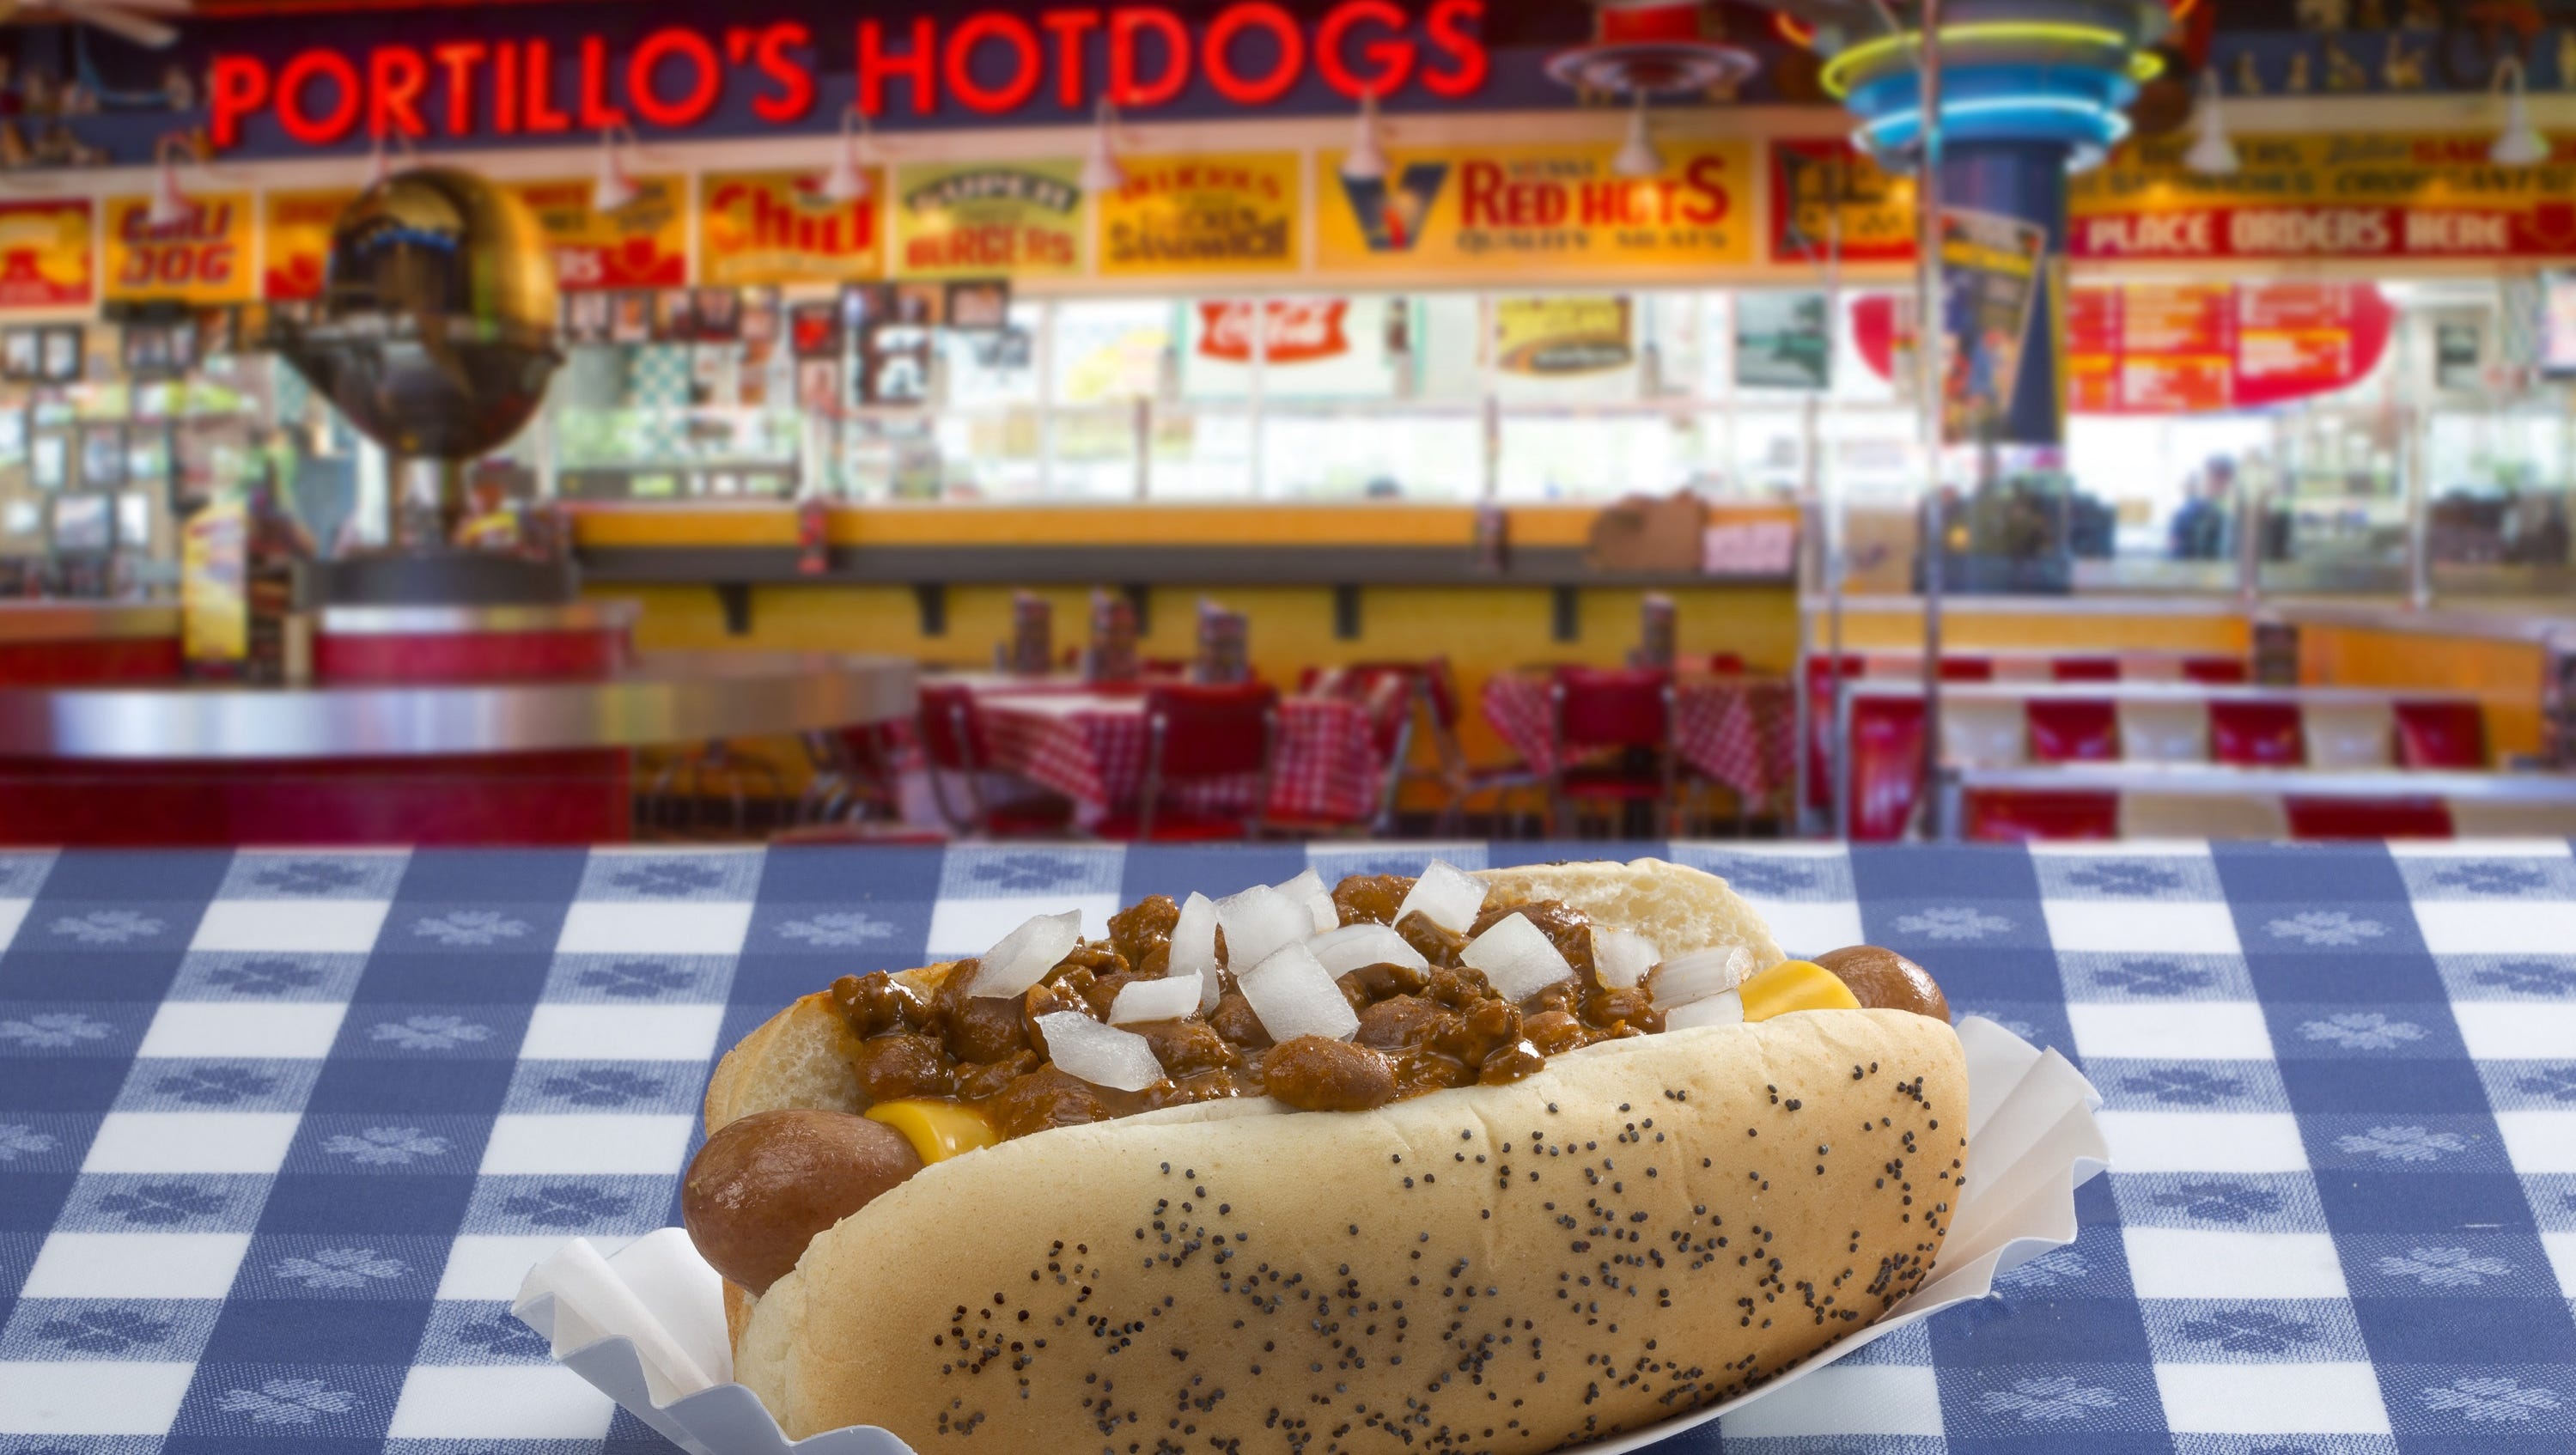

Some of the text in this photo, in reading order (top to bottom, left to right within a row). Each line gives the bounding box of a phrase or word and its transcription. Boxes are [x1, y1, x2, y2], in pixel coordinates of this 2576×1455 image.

[210, 0, 1489, 149] PORTILLO'S HOTDOGS
[1459, 159, 1570, 229] RED
[1577, 153, 1733, 227] HOTS
[904, 222, 1077, 271] BURGERS
[1455, 229, 1591, 254] QUALITY
[2086, 207, 2510, 253] PLACE ORDERS HERE
[119, 241, 237, 287] DOG
